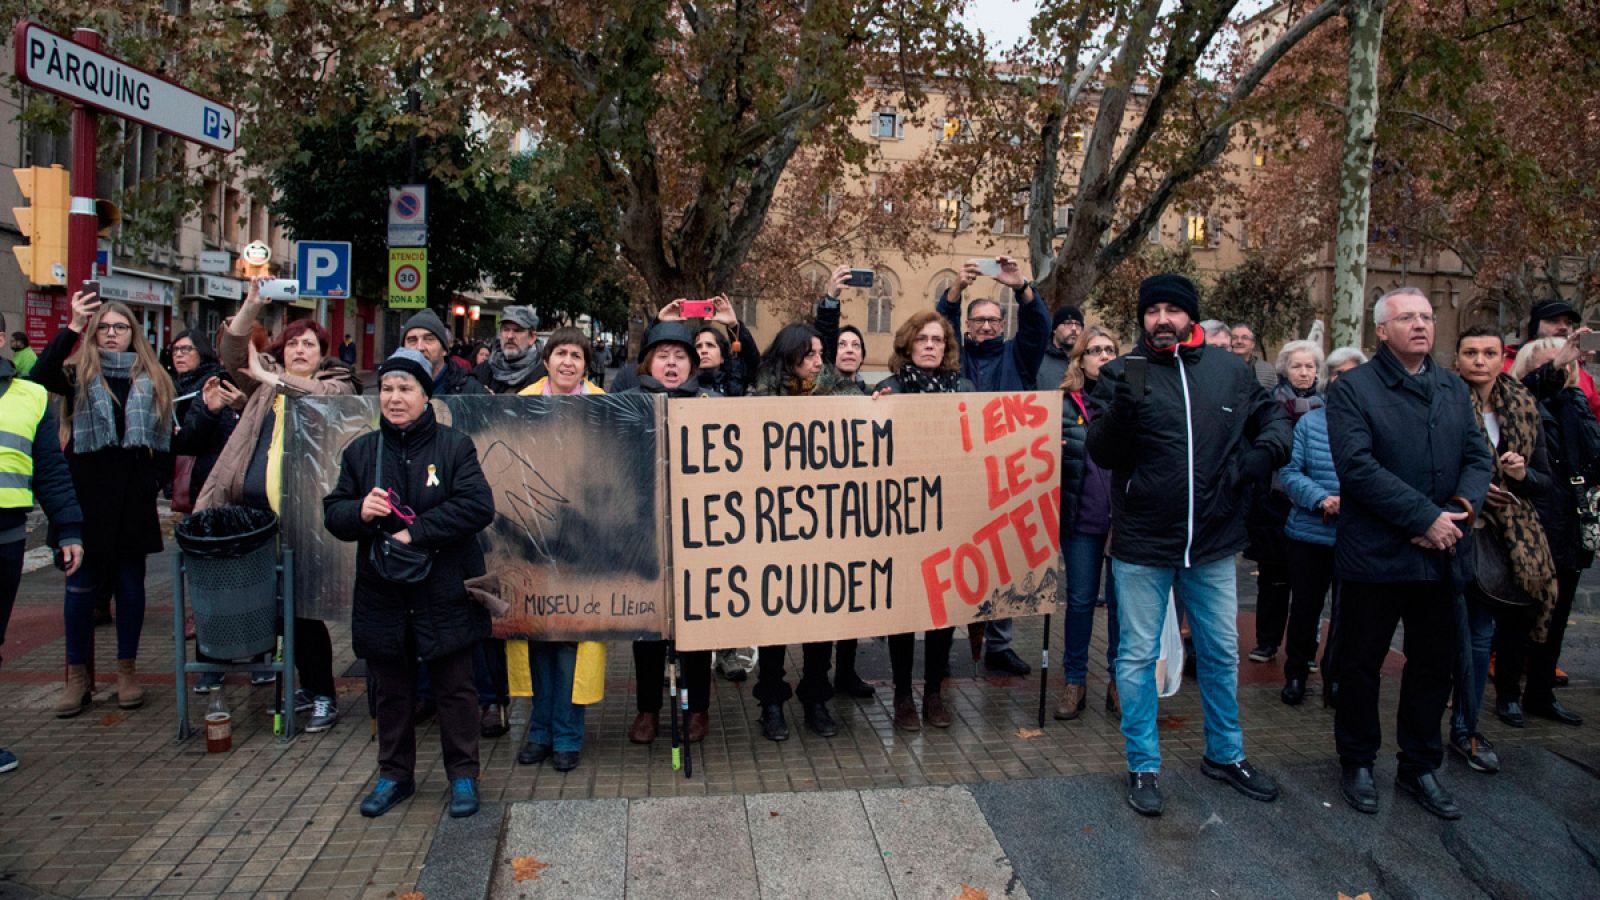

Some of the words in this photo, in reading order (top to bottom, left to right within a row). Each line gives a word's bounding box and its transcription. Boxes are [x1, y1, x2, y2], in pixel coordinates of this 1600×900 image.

[307, 248, 339, 290] P
[400, 273, 415, 282] 30
[390, 295, 413, 304] ZONA
[981, 393, 1049, 445] ENS
[681, 423, 744, 475] LES
[763, 418, 894, 473] PAGUEM
[983, 434, 1055, 511] LES
[681, 490, 746, 549] LES
[755, 475, 943, 544] RESTAUREM
[524, 594, 580, 617] MUSEU
[583, 595, 601, 615] de
[683, 564, 750, 622] LES
[761, 556, 893, 617] CUIDEM
